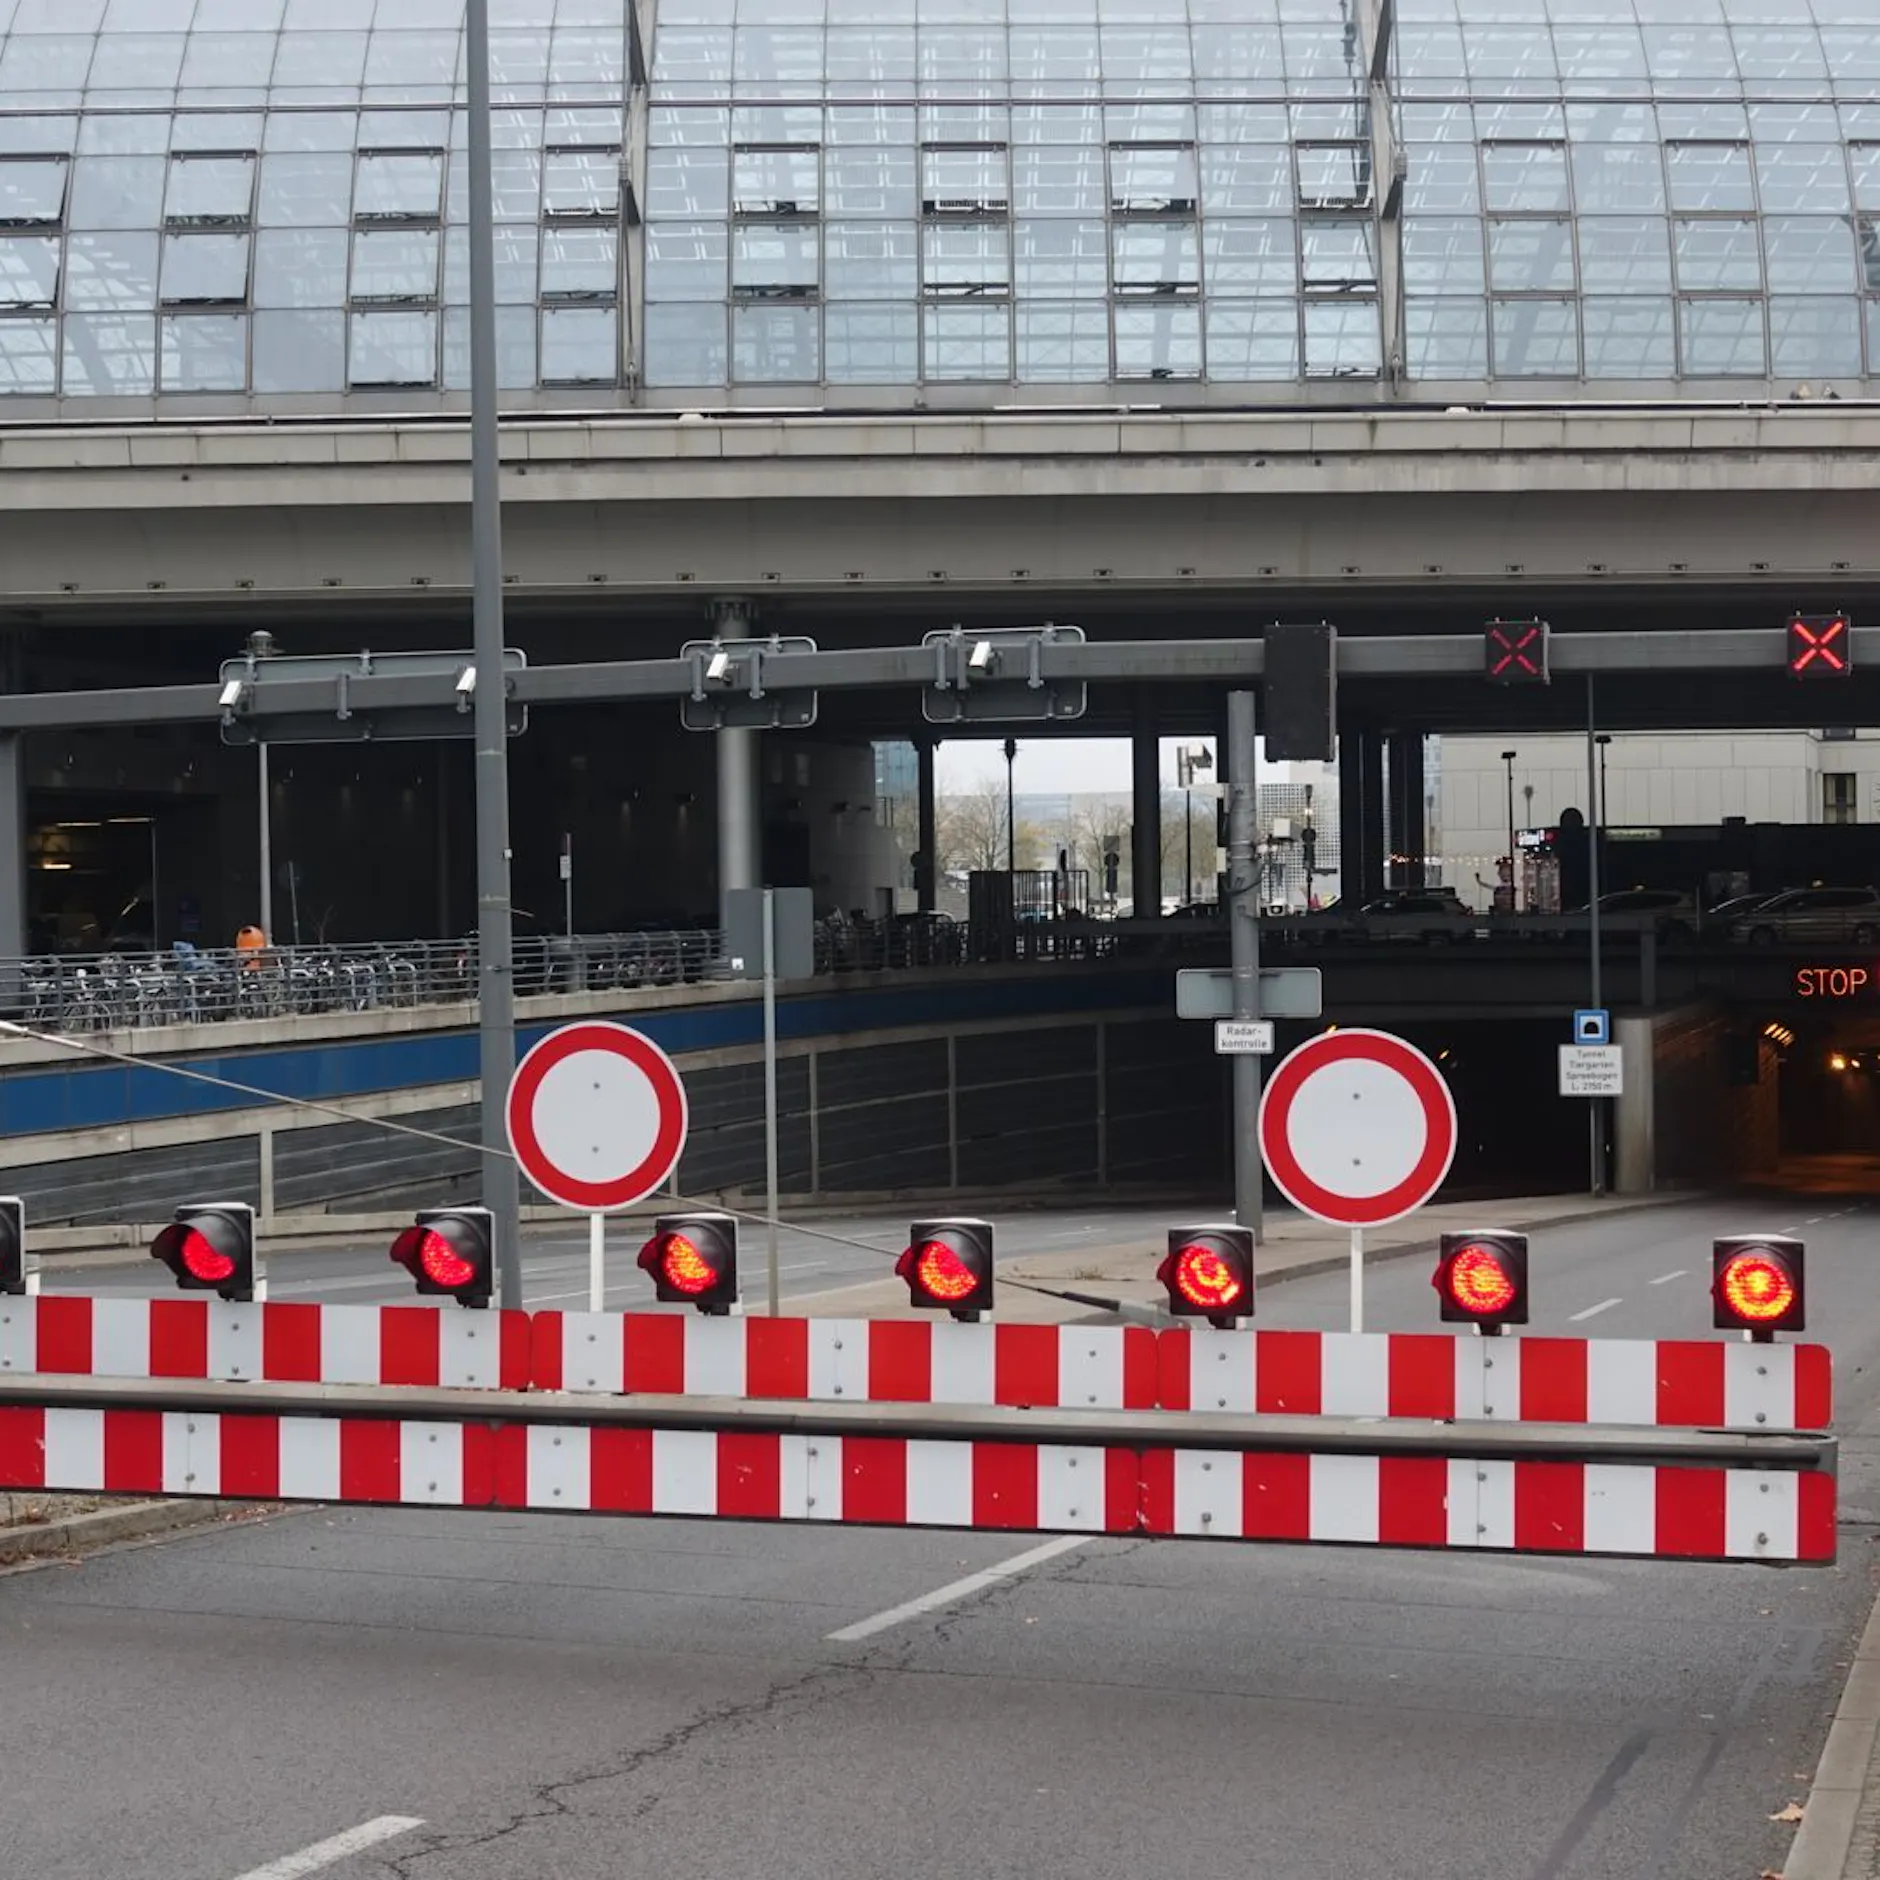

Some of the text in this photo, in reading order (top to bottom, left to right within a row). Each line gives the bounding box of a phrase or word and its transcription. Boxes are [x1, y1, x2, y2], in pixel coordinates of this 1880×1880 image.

[1797, 968, 1868, 996] STOP
[1226, 1025, 1262, 1036] Radar-
[1221, 1039, 1268, 1049] kontrolle
[1577, 1049, 1606, 1059] Tunnel
[1569, 1060, 1615, 1071] Tiergarten
